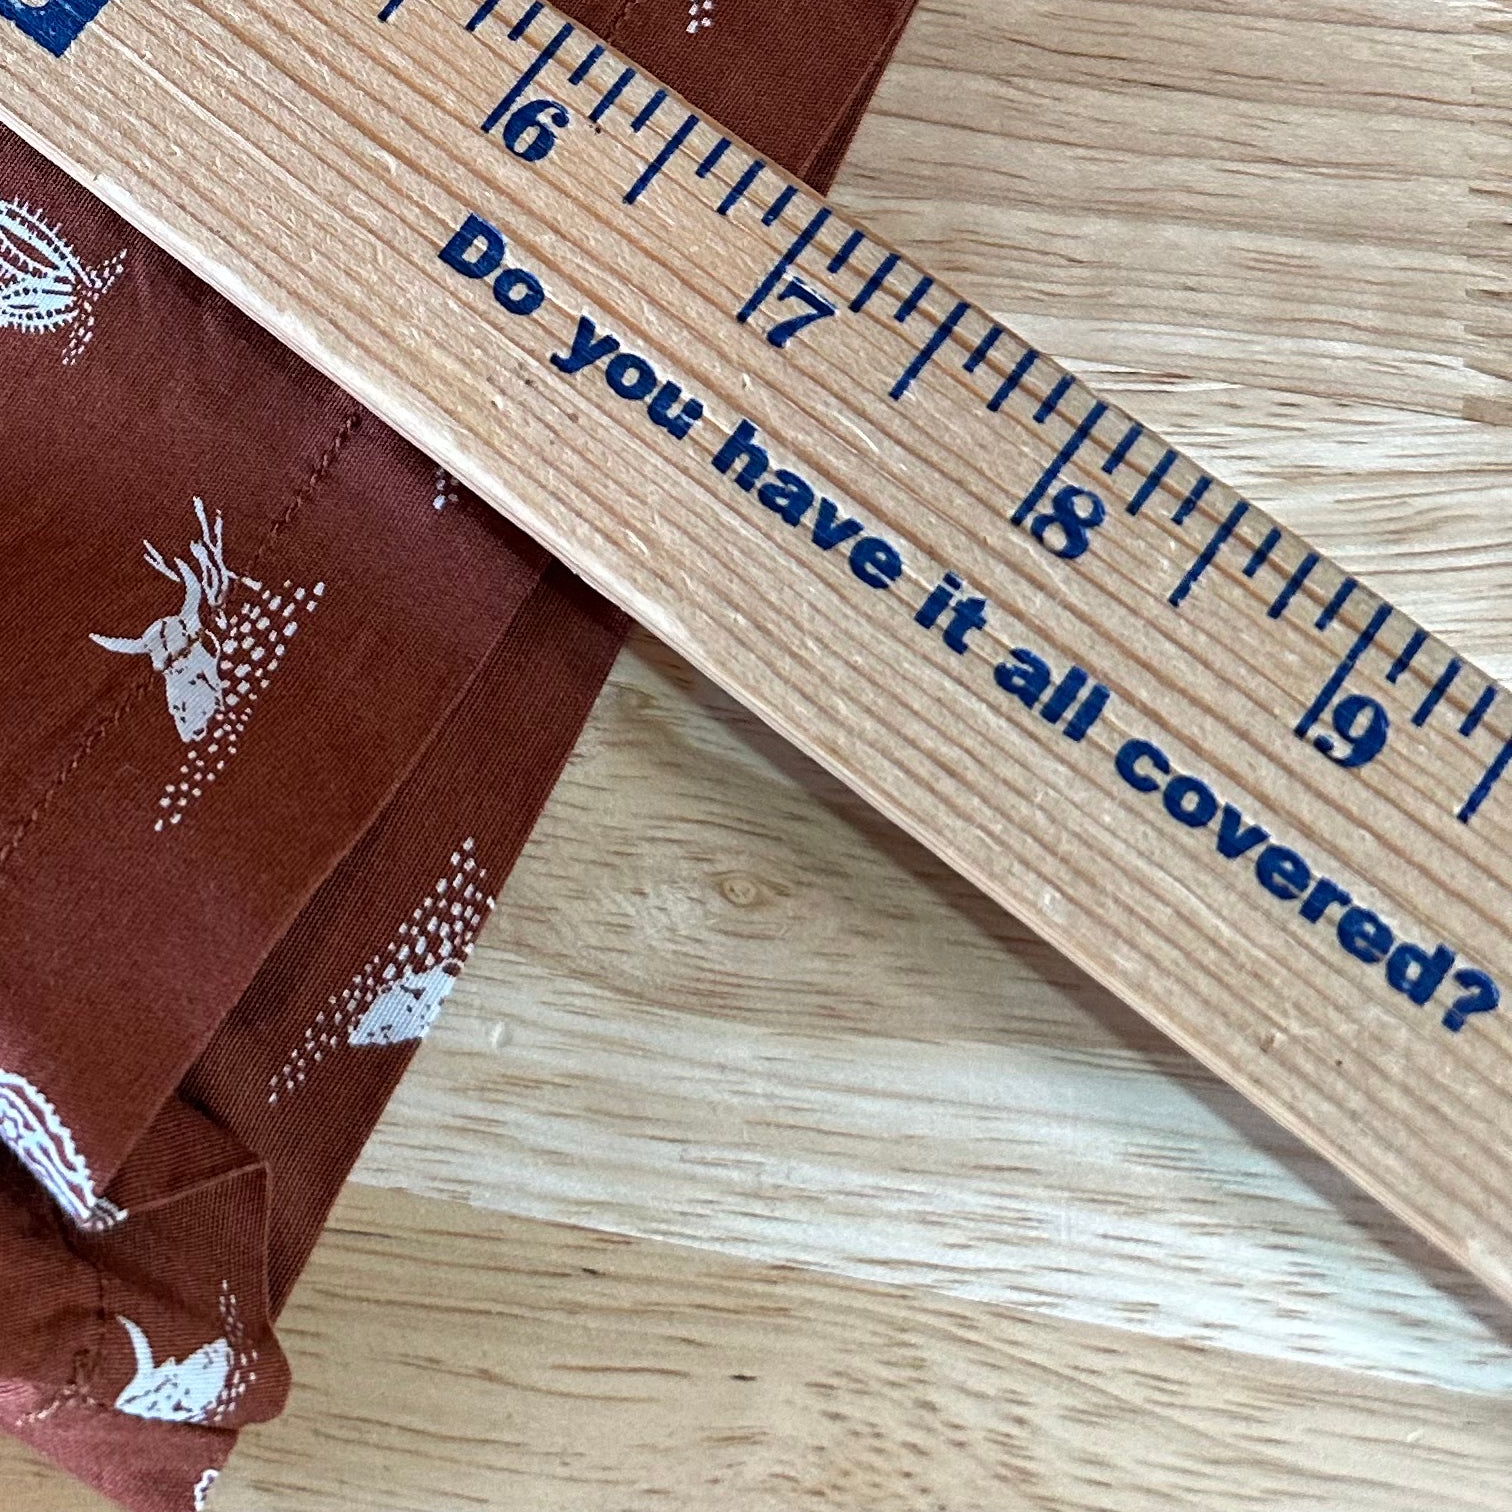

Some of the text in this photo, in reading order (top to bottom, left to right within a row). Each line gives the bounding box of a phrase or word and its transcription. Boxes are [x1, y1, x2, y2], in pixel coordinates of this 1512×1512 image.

[502, 99, 570, 162] 6
[765, 276, 838, 348] 7
[1030, 485, 1107, 560] 8
[437, 212, 1501, 1033] Do you have it all covered?
[1313, 694, 1390, 768] 9
